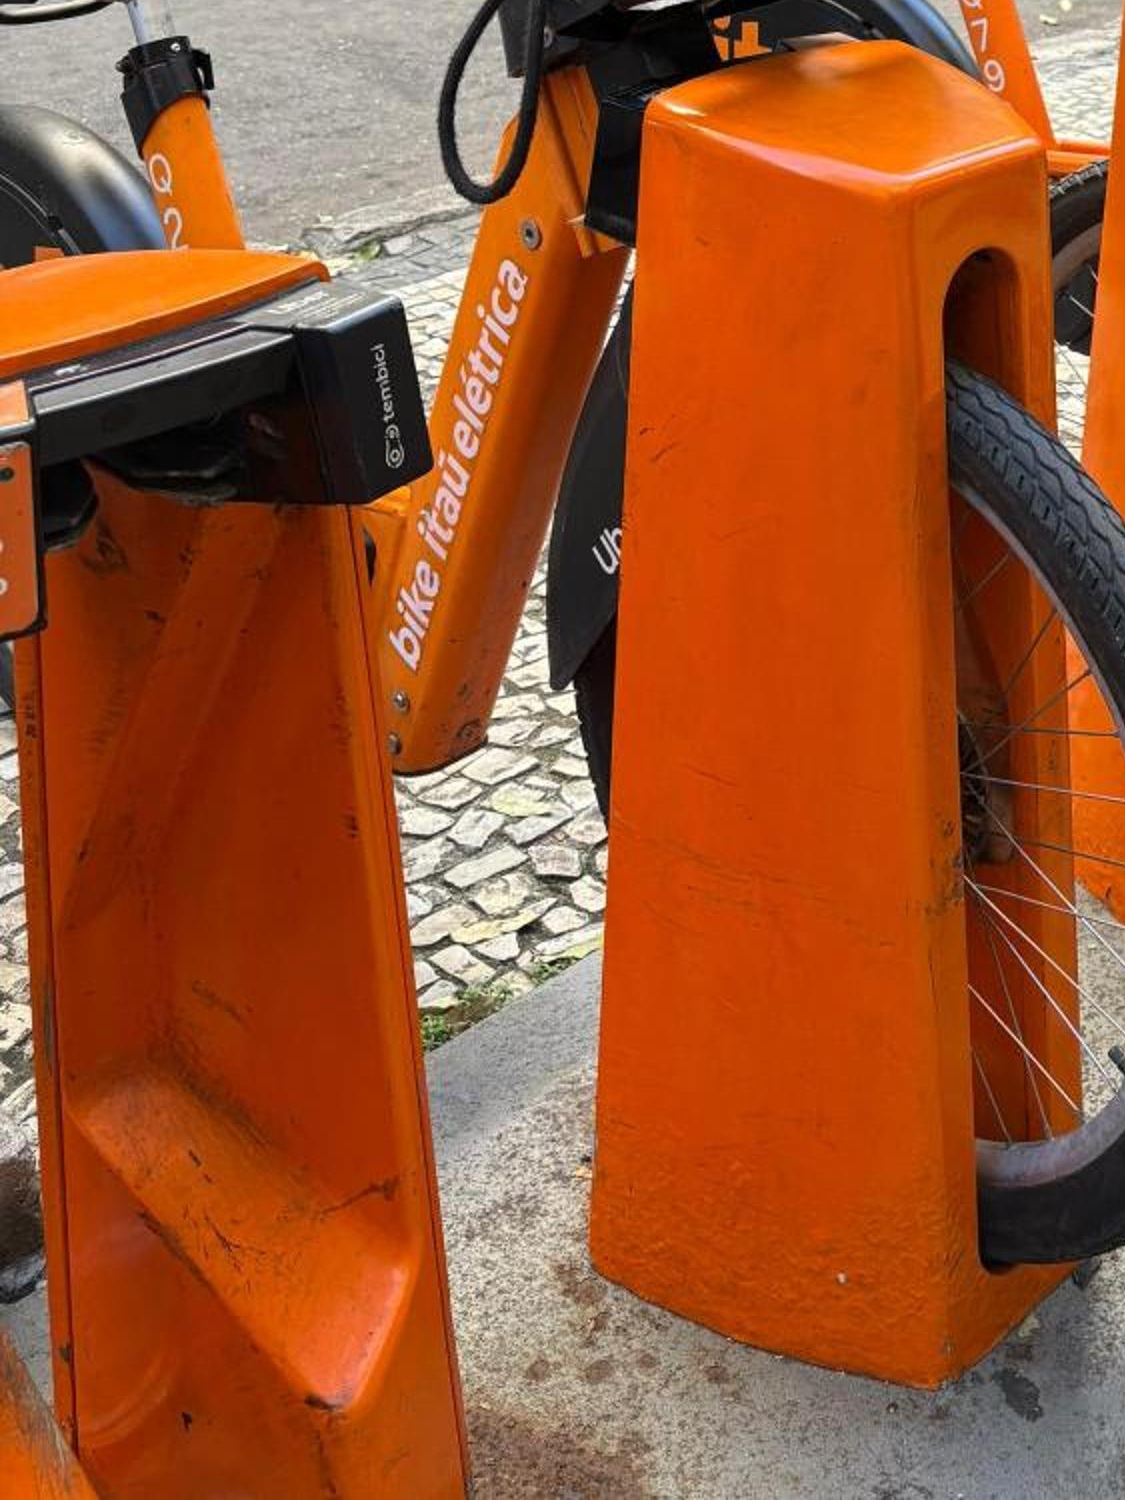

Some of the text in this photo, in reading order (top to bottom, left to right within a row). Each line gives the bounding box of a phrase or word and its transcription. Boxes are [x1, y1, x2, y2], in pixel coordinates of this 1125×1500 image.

[388, 258, 528, 672] bike itaú elétrica
